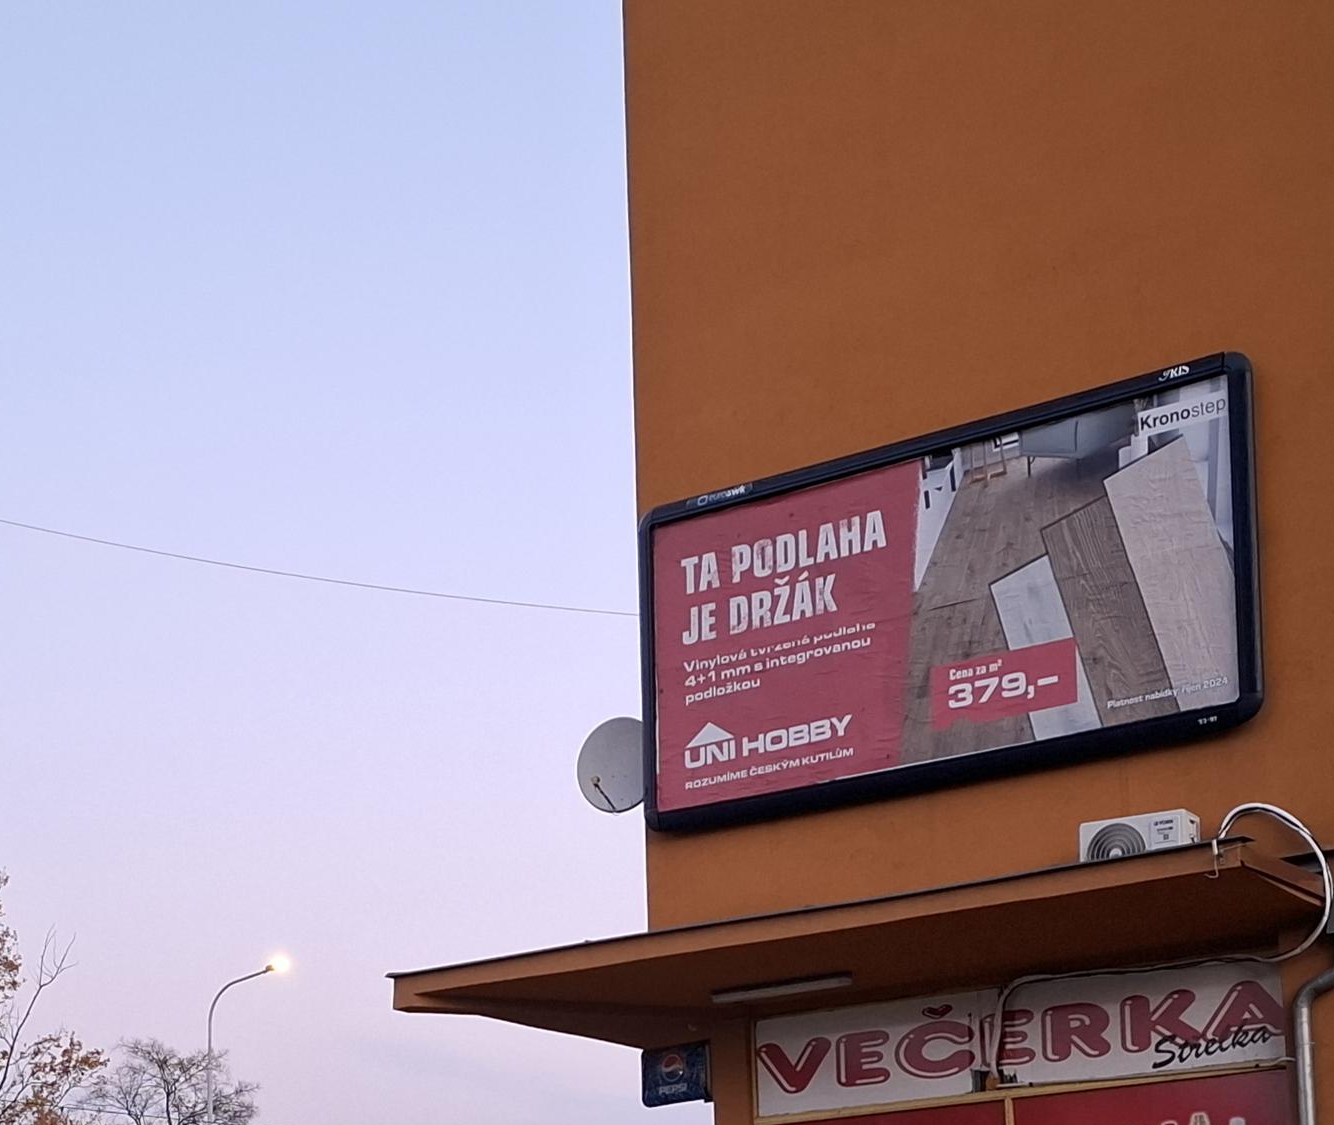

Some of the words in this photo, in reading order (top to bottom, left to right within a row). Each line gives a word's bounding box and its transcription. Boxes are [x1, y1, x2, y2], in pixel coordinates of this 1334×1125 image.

[1140, 398, 1226, 432] Kronostep
[681, 552, 720, 595] TA
[732, 510, 887, 583] PODLAHA
[682, 602, 716, 645] JE
[729, 571, 838, 635] DRŽÁK
[683, 648, 747, 673] Vinylová
[684, 671, 717, 688] 4+1
[720, 664, 751, 681] mm
[753, 661, 764, 672] s
[766, 636, 872, 666] integrovanou
[949, 667, 975, 681] Cena
[975, 664, 987, 675] za
[685, 677, 761, 706] podložkou
[1106, 693, 1144, 710] Platnost
[1202, 676, 1229, 692] 2024
[684, 739, 736, 769] UNI
[742, 714, 853, 757] HOBBY
[685, 769, 748, 790] ROZUMÍME
[749, 757, 801, 777] ČESKÝM
[756, 979, 1285, 1094] VEČERKA
